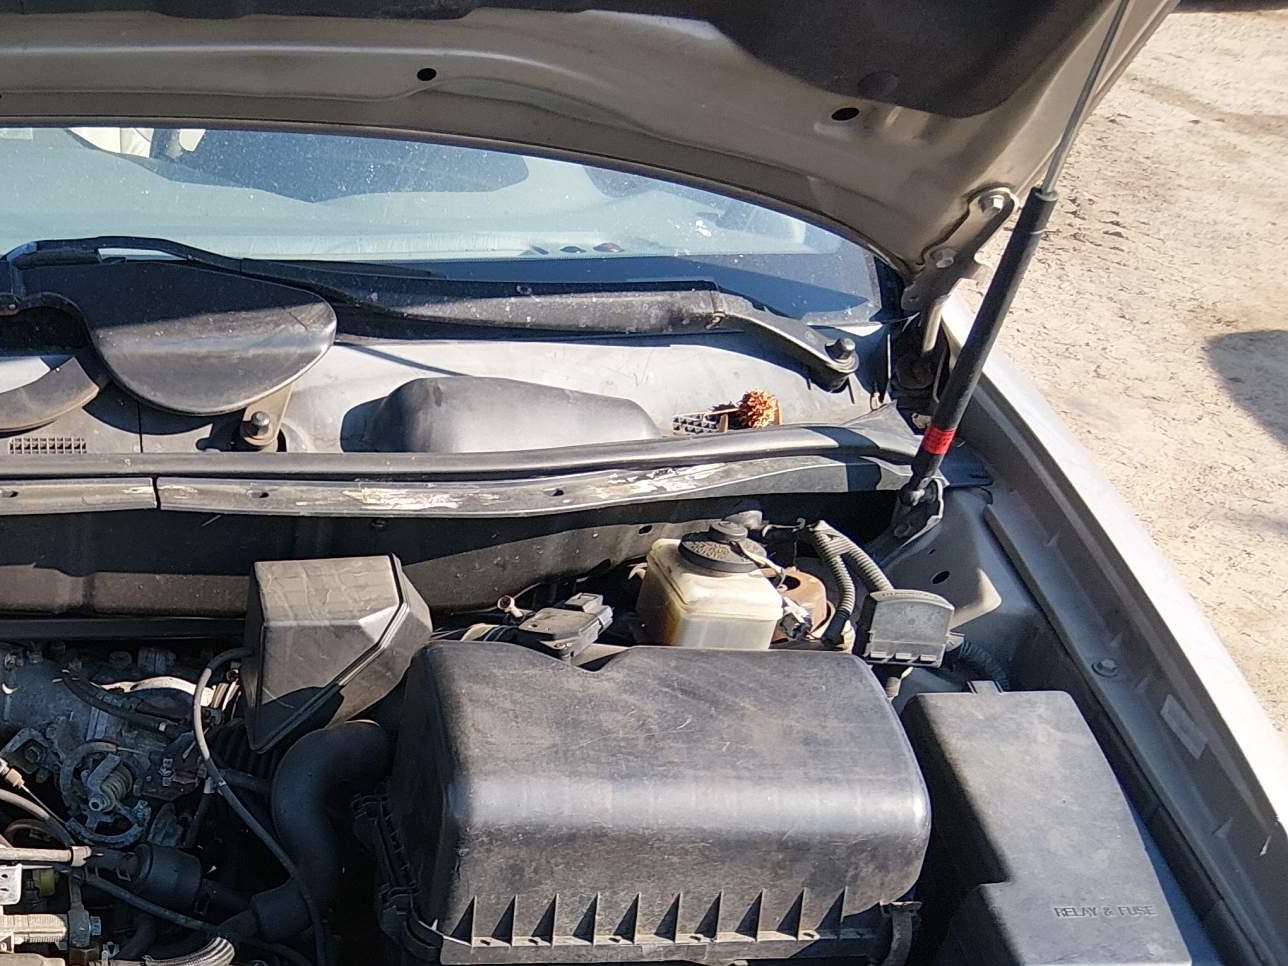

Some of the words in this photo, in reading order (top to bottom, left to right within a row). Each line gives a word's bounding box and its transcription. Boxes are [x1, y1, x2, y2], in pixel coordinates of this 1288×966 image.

[1054, 906, 1097, 918] RELAY
[1103, 907, 1113, 916] &
[1118, 905, 1156, 916] FUSE
